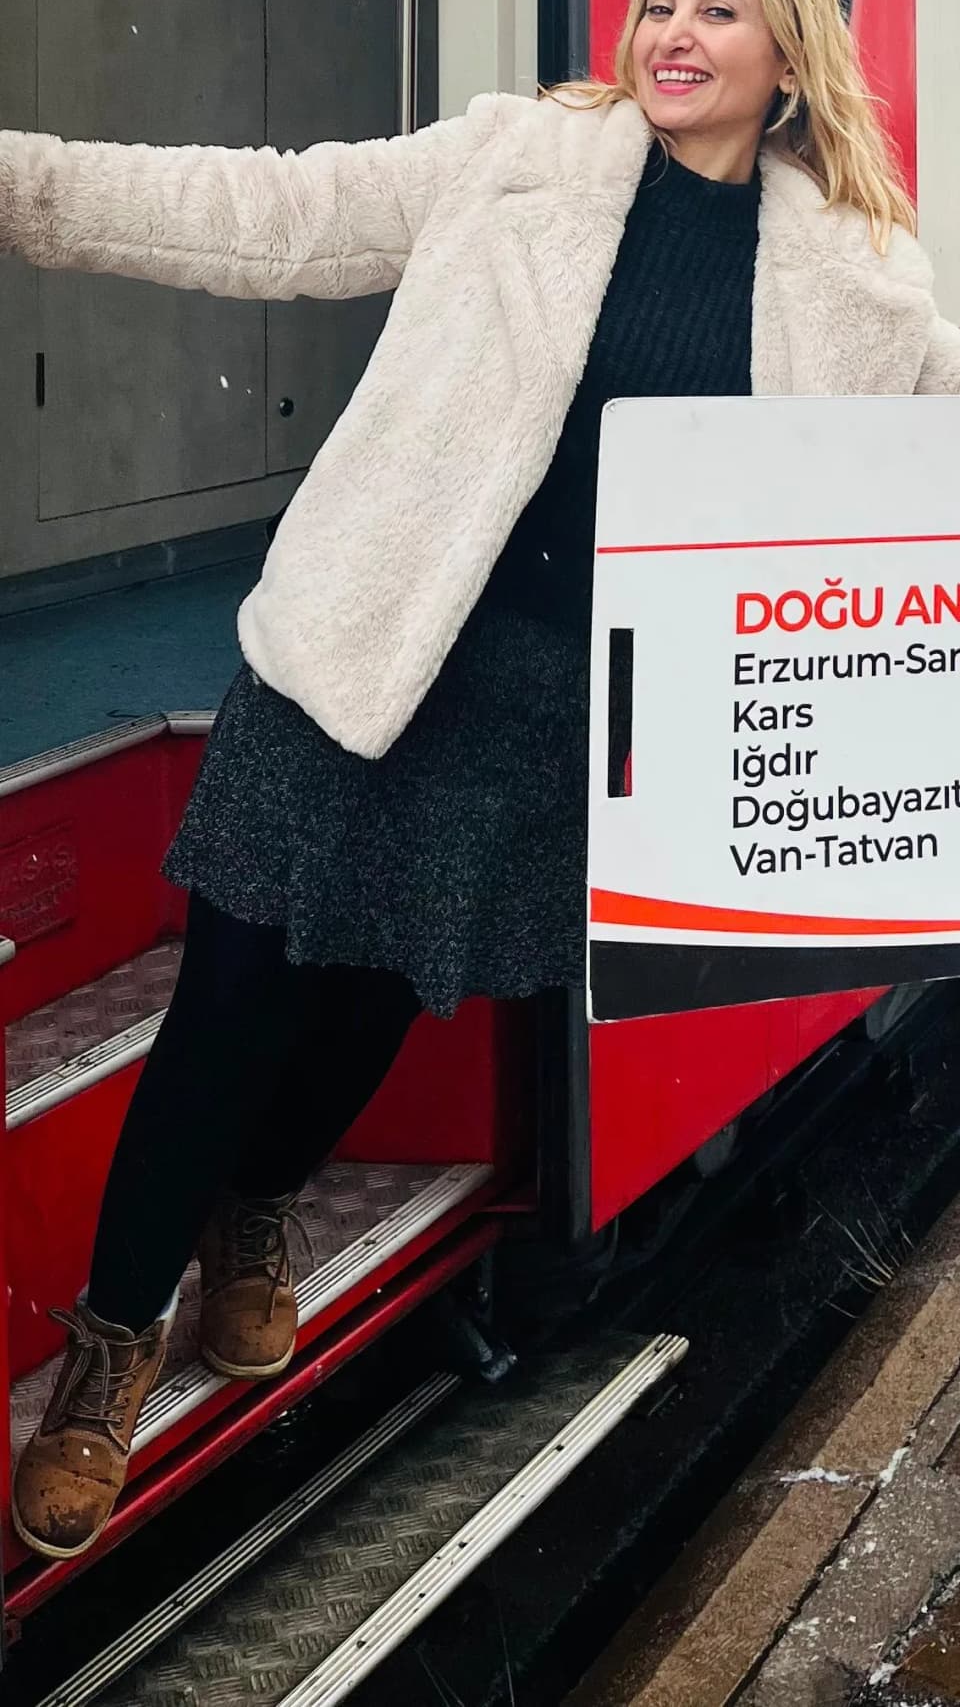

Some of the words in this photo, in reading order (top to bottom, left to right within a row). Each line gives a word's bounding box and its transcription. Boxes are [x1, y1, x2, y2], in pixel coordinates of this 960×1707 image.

[735, 577, 885, 636] DOĞU
[732, 699, 815, 735] Kars
[732, 747, 820, 789] Iğdır
[729, 833, 939, 878] Van-Tatvan
